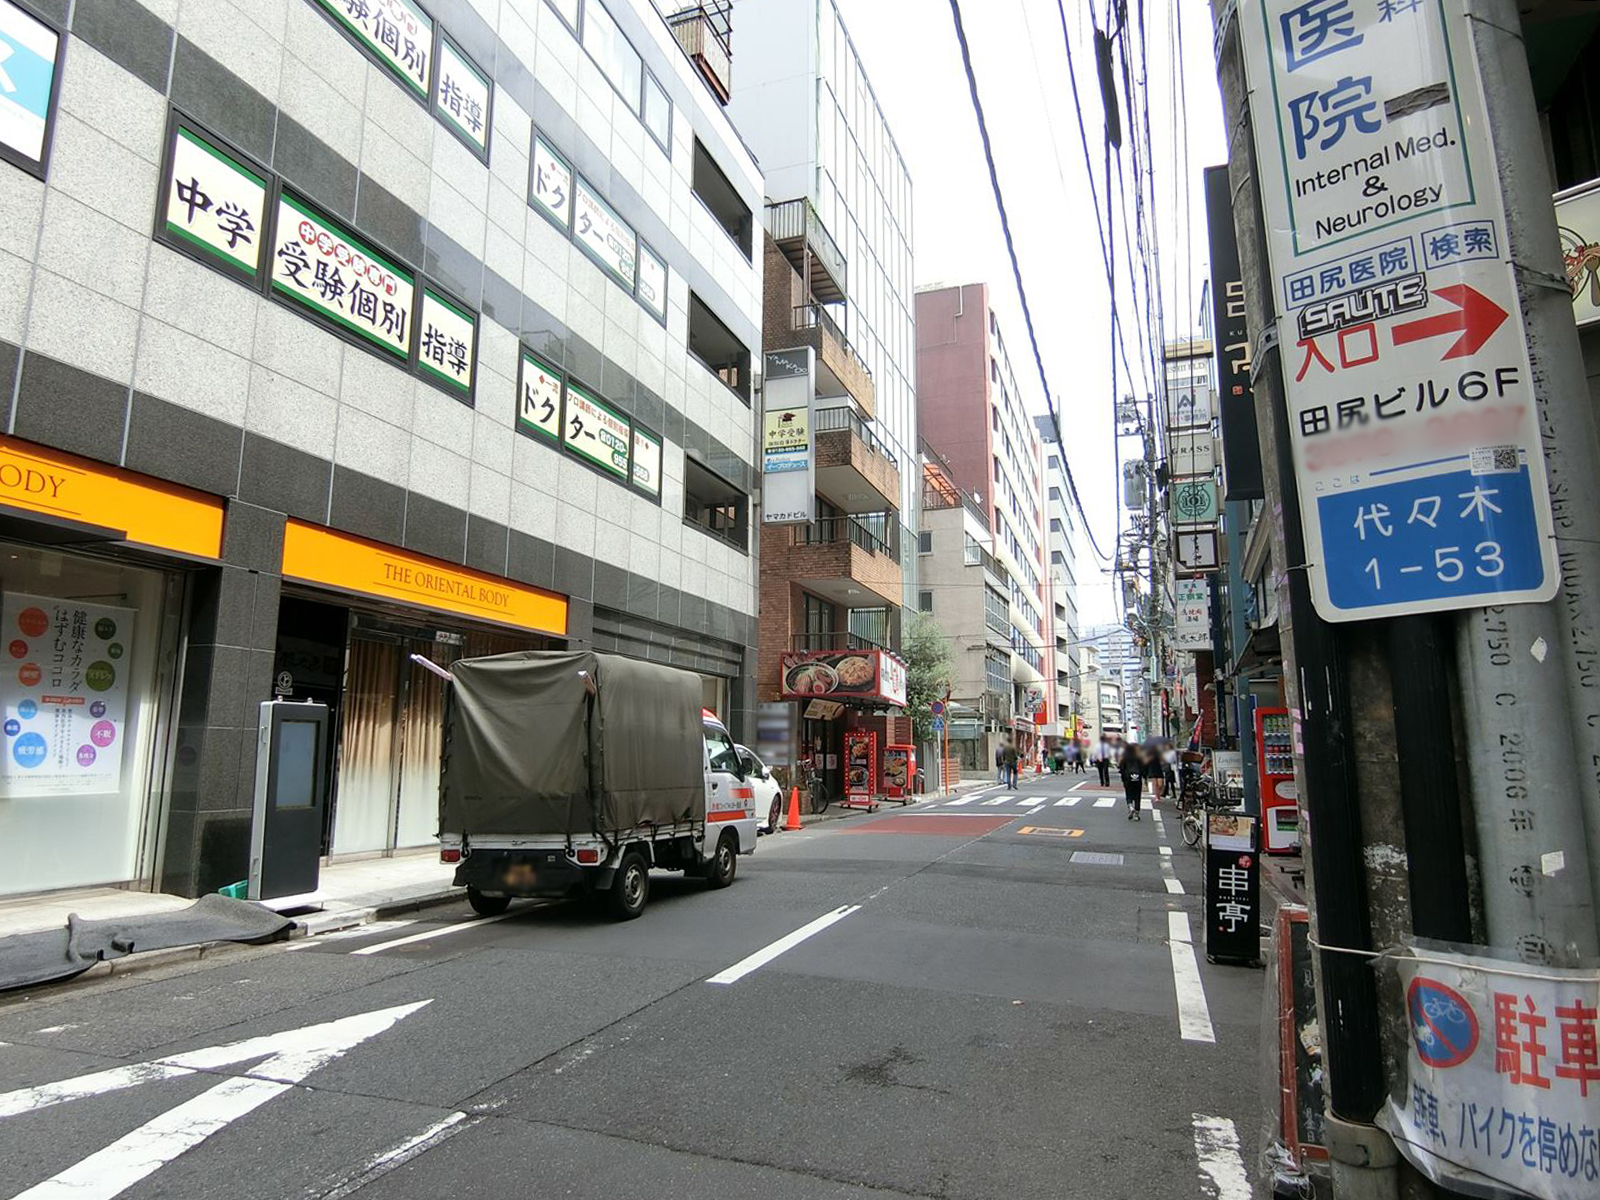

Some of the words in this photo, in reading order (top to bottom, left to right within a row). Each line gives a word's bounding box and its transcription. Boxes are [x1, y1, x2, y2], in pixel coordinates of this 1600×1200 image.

[440, 74, 483, 132] 指導
[1295, 147, 1390, 198] Internal
[1394, 127, 1457, 161] Med.
[1362, 176, 1388, 197] &
[1314, 182, 1443, 240] Neurology
[176, 177, 256, 250] 中学
[277, 241, 408, 344] 受験個別
[421, 322, 470, 377] 指導
[1290, 247, 1410, 302] 田尻医院
[1429, 226, 1494, 259] 検索
[1298, 273, 1428, 339] SAUTE
[1295, 322, 1380, 383] 入口
[1300, 367, 1519, 437] 田尻ビル6F
[1354, 485, 1503, 541] 代々木
[384, 563, 412, 584] THE
[414, 571, 477, 600] ORIENTAL
[479, 587, 510, 608] BODY
[1364, 541, 1505, 590] 1-53
[52, 609, 69, 688] はずむココロ
[70, 610, 88, 694] 健康なカラダ
[1216, 864, 1252, 932] 串亭
[1493, 992, 1600, 1098] 駐車
